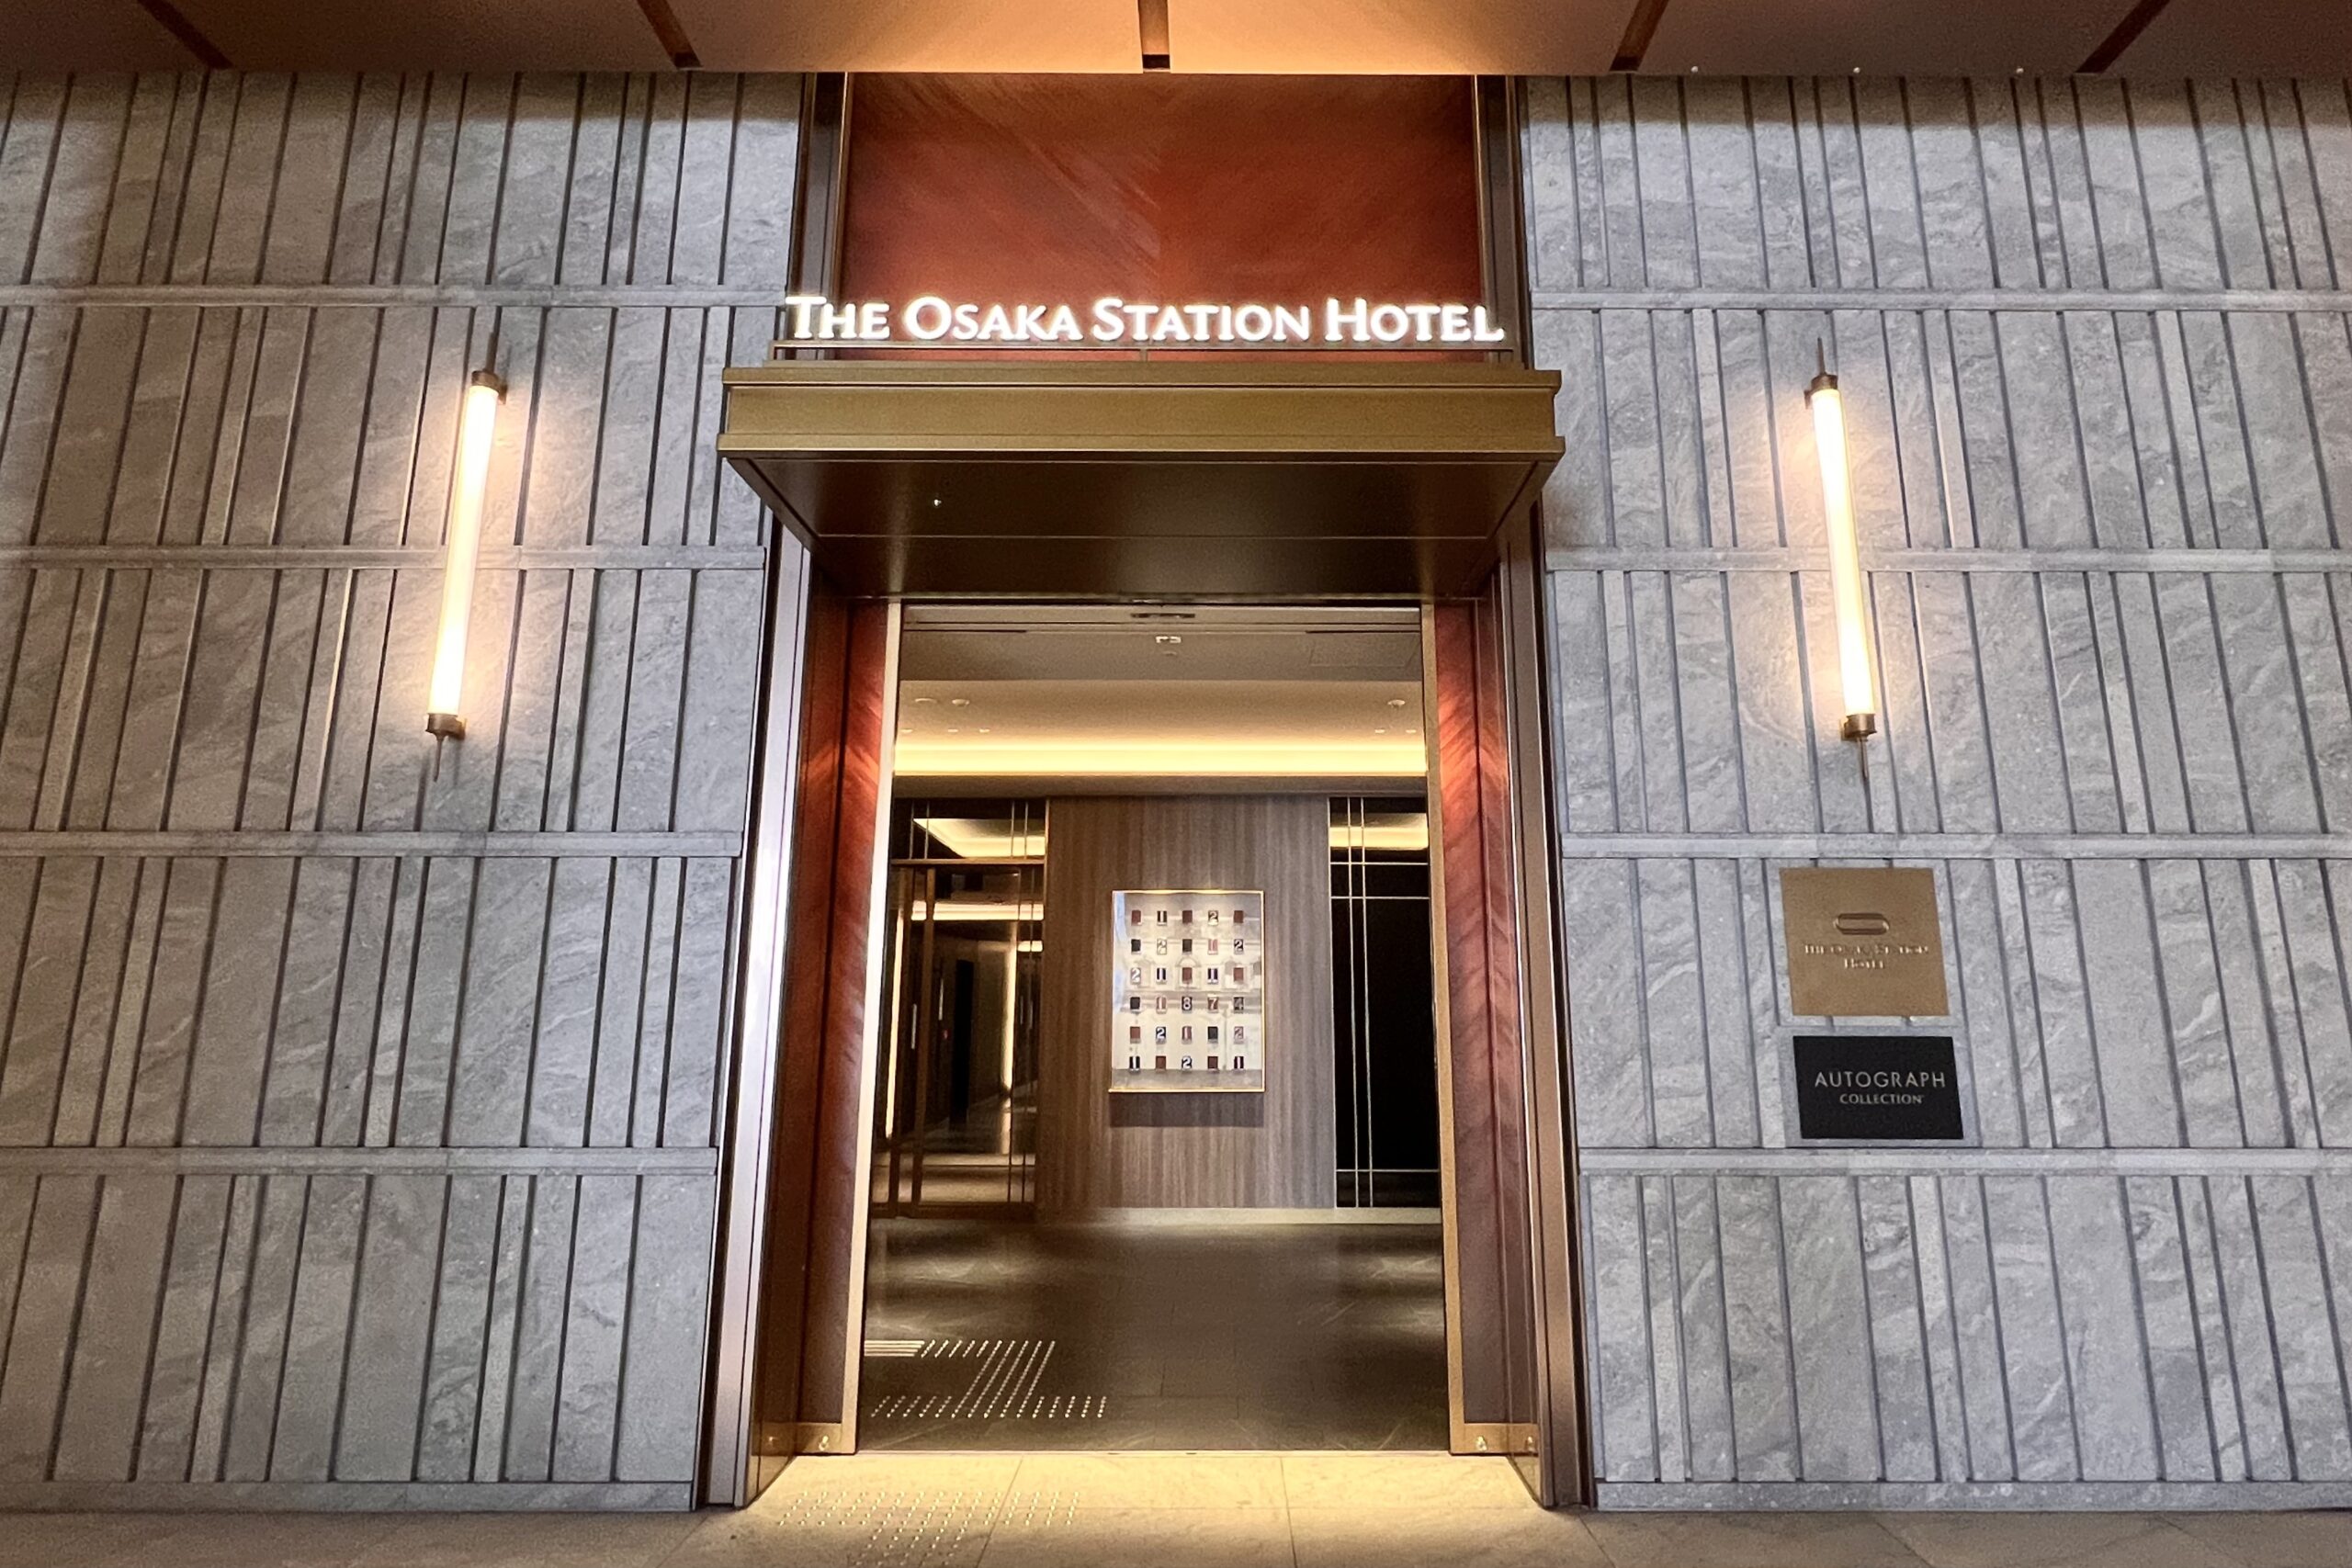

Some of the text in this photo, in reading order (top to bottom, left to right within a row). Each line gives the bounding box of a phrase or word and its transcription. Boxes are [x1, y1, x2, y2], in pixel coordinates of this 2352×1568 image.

[786, 296, 1505, 343] THE OSAKA STATION HOTEL
[1234, 939, 1243, 953] 2
[1131, 967, 1141, 984] 2
[1182, 997, 1192, 1011] 8
[1208, 998, 1218, 1011] 7
[1156, 1026, 1166, 1041] 2
[1182, 1055, 1192, 1069] 2
[1815, 1071, 1945, 1088] AUTOGRAPH
[1839, 1093, 1922, 1104] COLLECTION
